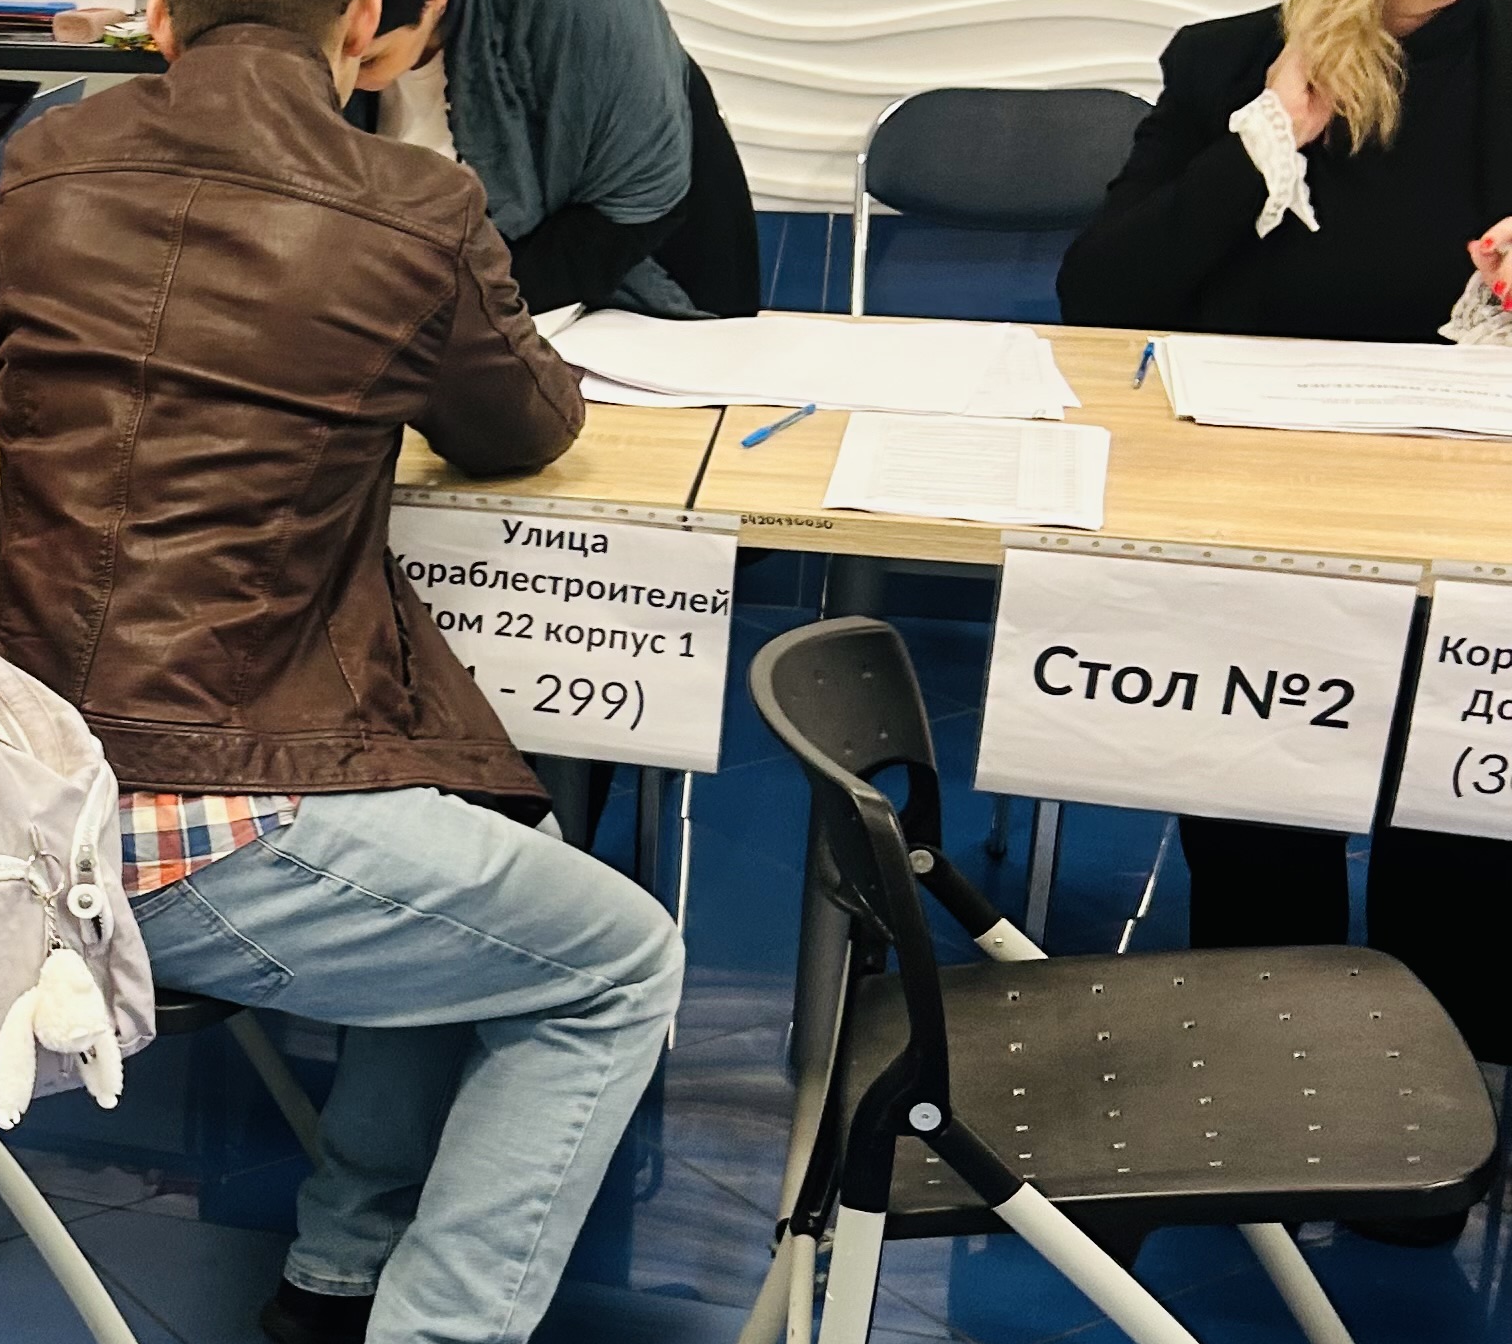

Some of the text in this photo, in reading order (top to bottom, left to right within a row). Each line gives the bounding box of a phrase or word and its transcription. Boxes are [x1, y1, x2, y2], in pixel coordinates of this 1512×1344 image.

[502, 519, 609, 557] Улица
[396, 553, 730, 616] ораблестроителей
[423, 602, 695, 658] ом 22 корпус 1
[532, 673, 645, 731] 299)
[1032, 645, 1356, 730] Стол №2
[1452, 746, 1512, 798] (3
